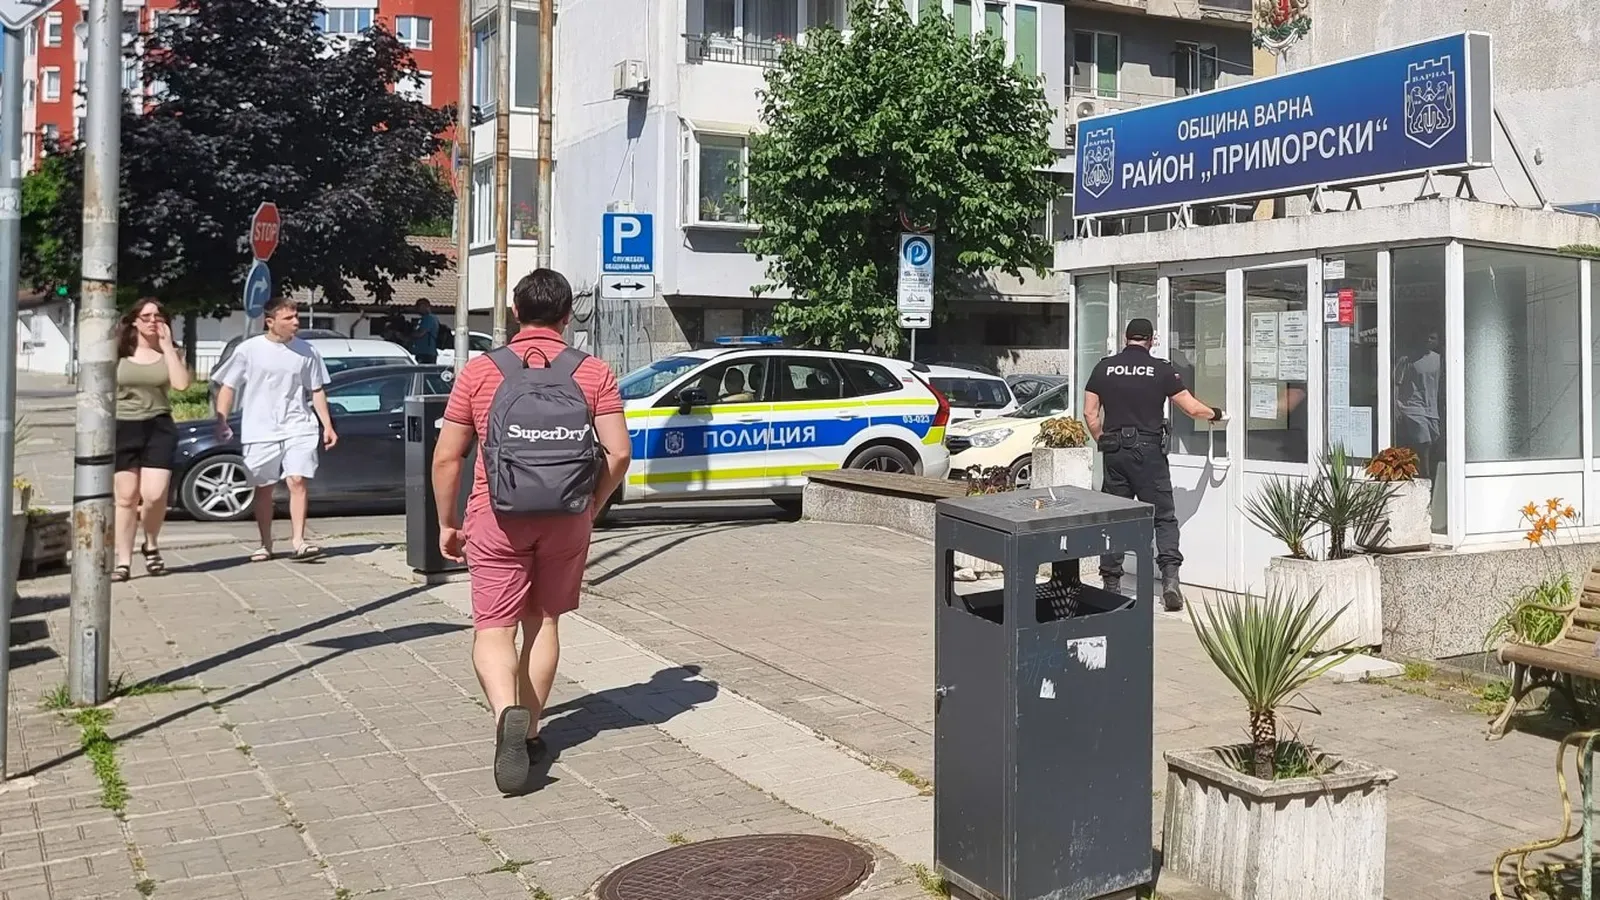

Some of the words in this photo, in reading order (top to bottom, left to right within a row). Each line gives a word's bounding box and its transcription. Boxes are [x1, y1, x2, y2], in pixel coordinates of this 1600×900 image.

[1412, 71, 1446, 82] ВАРНА
[1178, 109, 1250, 141] ОБЩИНА
[1254, 95, 1314, 127] ВАРНА
[1121, 150, 1194, 190] РАЙОН
[254, 221, 278, 242] STOP
[613, 215, 642, 254] P
[1106, 365, 1155, 377] POLICE
[902, 414, 930, 424] 03-023
[702, 425, 817, 449] ПОЛИЦИЯ
